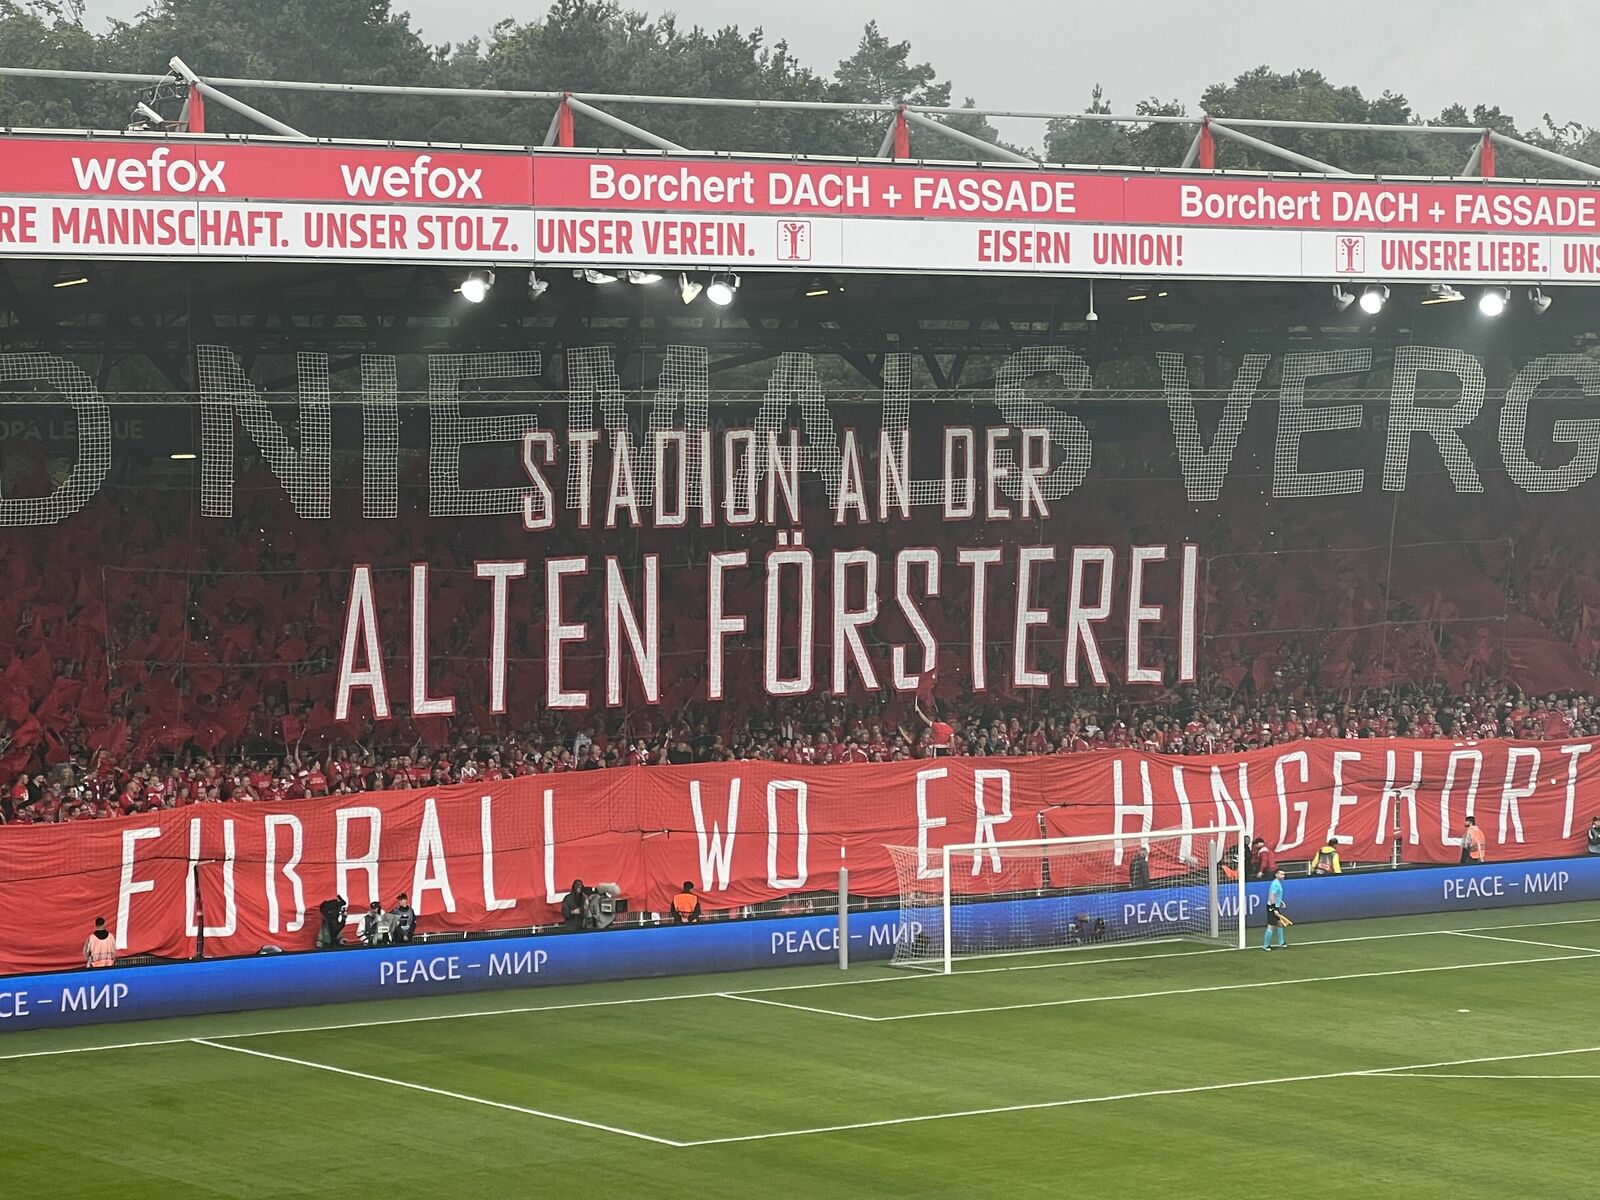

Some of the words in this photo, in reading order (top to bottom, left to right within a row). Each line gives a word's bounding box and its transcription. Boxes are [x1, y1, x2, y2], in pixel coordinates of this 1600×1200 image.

[71, 147, 226, 193] wefox
[340, 155, 483, 199] wefox
[589, 163, 755, 205] Borchert
[768, 171, 870, 208] DACH
[882, 187, 902, 207] +
[913, 177, 1077, 213] FASSADE
[1180, 184, 1321, 222] Borchert
[1332, 191, 1418, 223] DACH
[1429, 205, 1446, 223] +
[1455, 194, 1596, 227] FASSADE
[0, 205, 37, 243] RE
[52, 208, 289, 248] MANNSCHAFT.
[304, 213, 408, 249] UNSER
[417, 216, 519, 252] STOLZ.
[537, 218, 633, 254] UNSER
[642, 221, 756, 257] VEREIN.
[978, 230, 1071, 264] EISERN
[1093, 233, 1184, 267] UNION!
[1381, 239, 1471, 272] UNSERE
[1478, 242, 1548, 273] LIEBE.
[197, 342, 1092, 519] NIEMALS
[1156, 346, 1600, 501] VERG
[522, 427, 800, 530] STADION
[835, 428, 911, 524] AN
[942, 425, 1051, 520] DER
[333, 555, 660, 721] ALTEN
[707, 530, 1198, 702] FÖRSTEREI
[689, 777, 808, 893] WO
[916, 767, 1012, 880] ER
[1112, 741, 1593, 866] HINGEHÖRT
[1443, 876, 1503, 900] PEACE
[1525, 870, 1570, 894] МИР
[1124, 900, 1190, 925] PEACE
[869, 922, 923, 947] МИР
[379, 957, 461, 985] PEACE
[488, 950, 548, 977] МИР
[61, 983, 129, 1013] МИР
